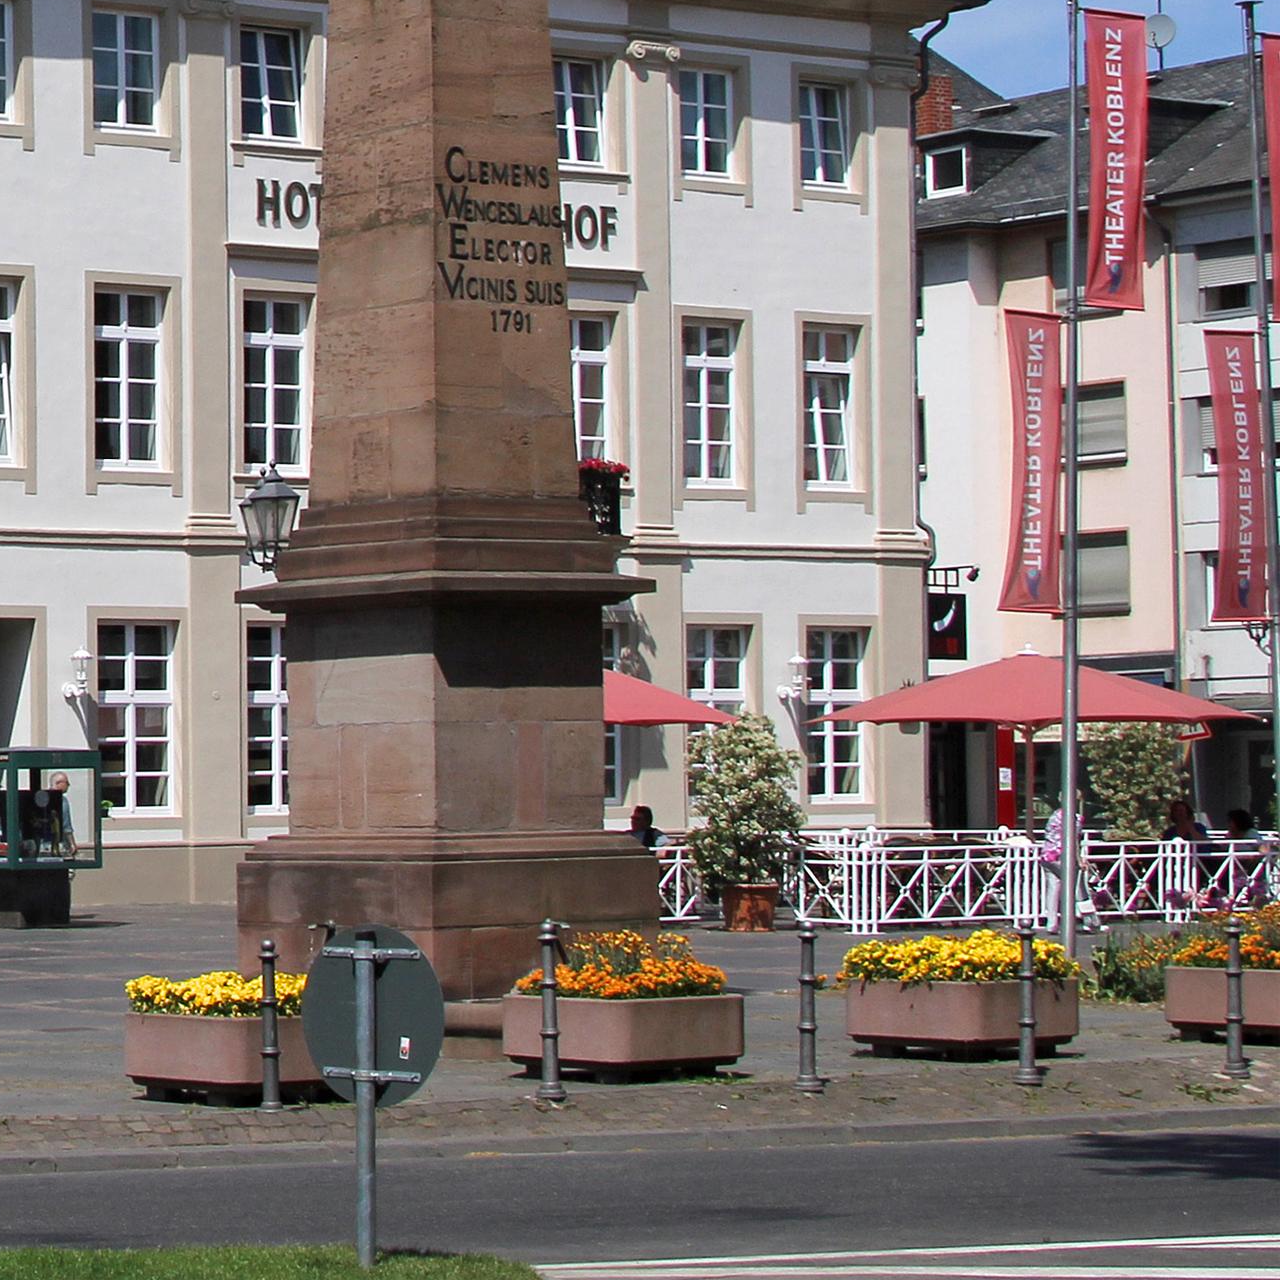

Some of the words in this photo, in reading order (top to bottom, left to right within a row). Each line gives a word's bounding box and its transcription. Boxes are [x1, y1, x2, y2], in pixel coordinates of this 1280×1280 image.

[1105, 27, 1125, 145] KOBLENZ
[1105, 151, 1125, 266] THEATER
[490, 308, 532, 334] 1791
